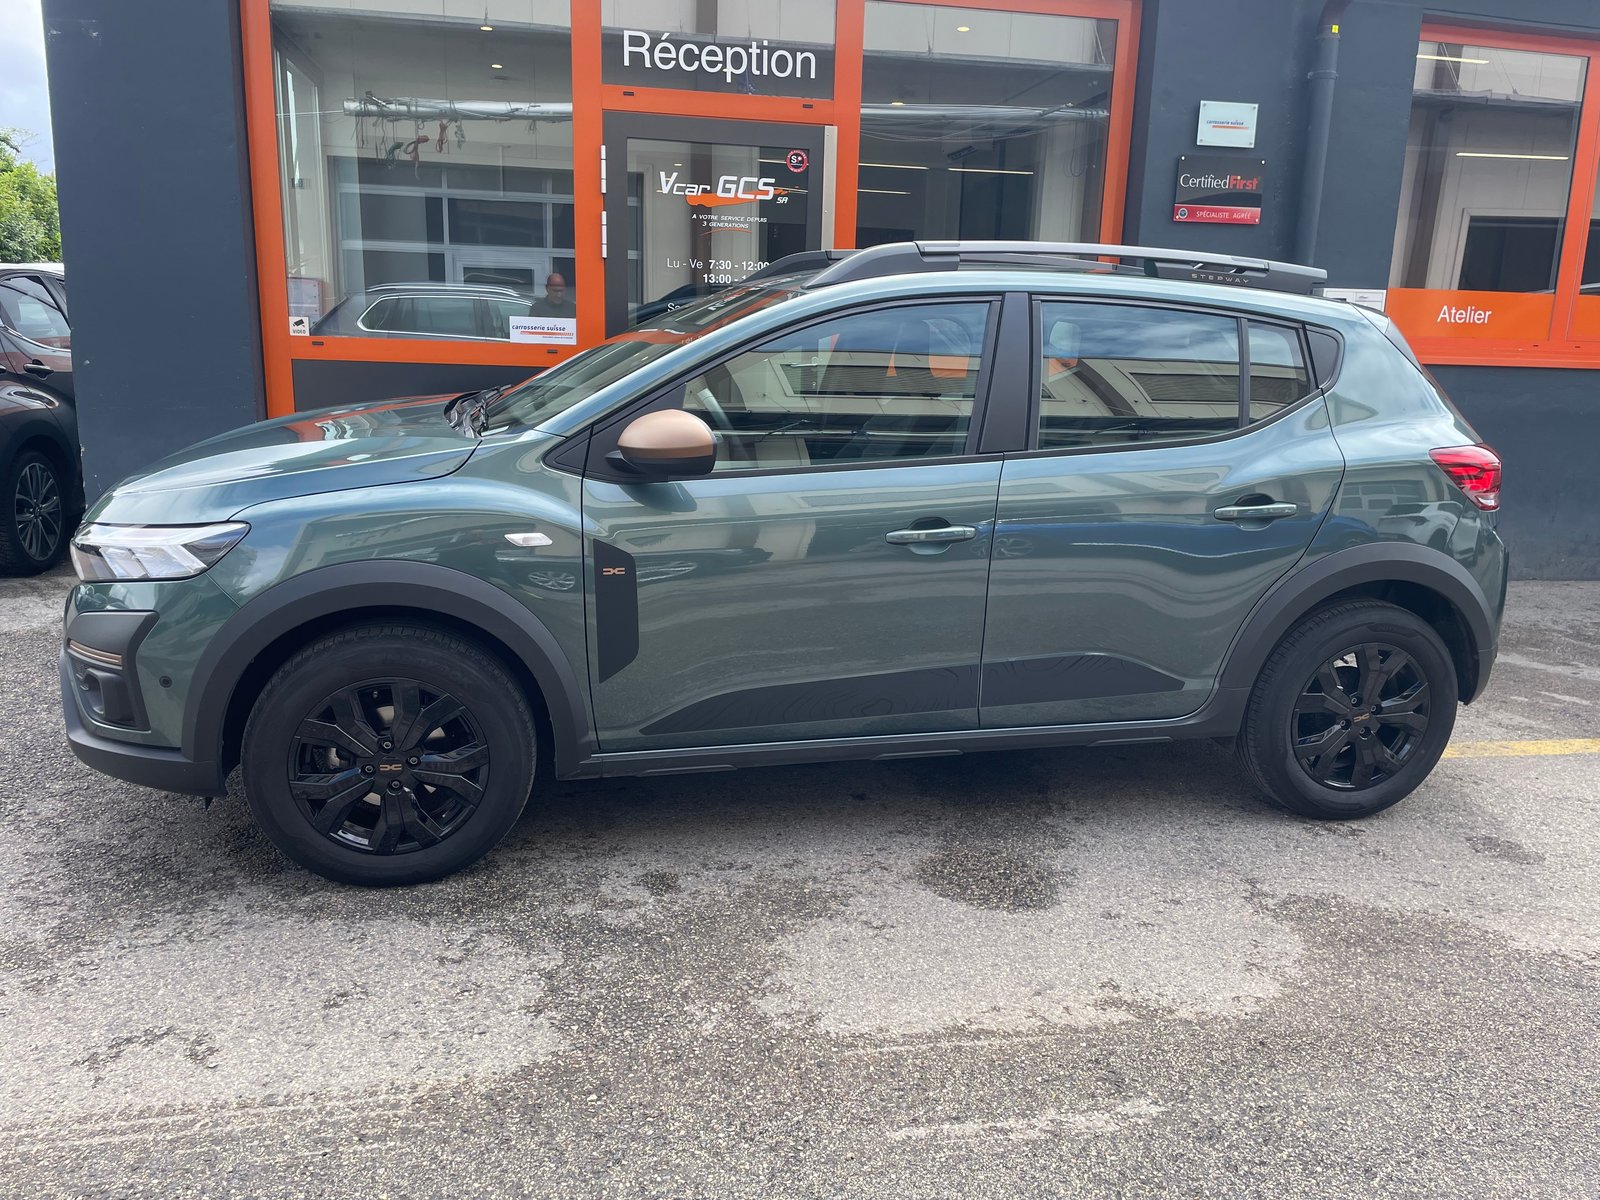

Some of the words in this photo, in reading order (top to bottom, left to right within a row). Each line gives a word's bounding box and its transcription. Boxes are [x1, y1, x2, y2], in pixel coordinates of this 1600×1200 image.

[622, 29, 816, 83] Réception
[660, 171, 711, 196] Vcar
[716, 176, 776, 200] GCS
[776, 196, 788, 204] SA
[1196, 210, 1230, 219] SPÉCIALISTE
[1232, 212, 1252, 220] AGRÉE
[666, 258, 680, 268] Lu
[689, 258, 703, 269] Ve
[708, 260, 732, 270] 7:30
[703, 274, 732, 284] 13:00
[1192, 274, 1249, 284] STEPWAY
[1437, 305, 1492, 324] Atelier
